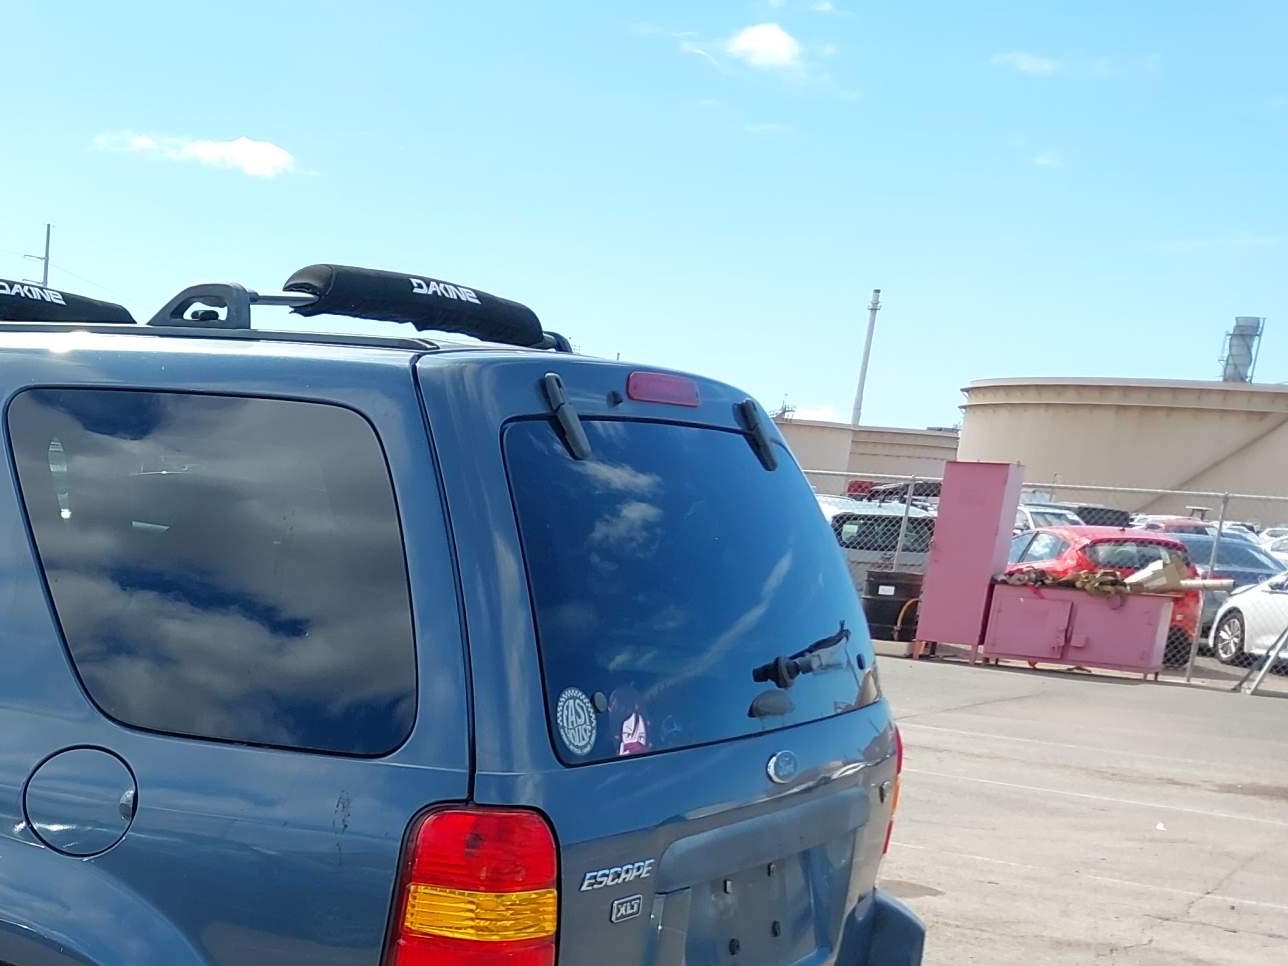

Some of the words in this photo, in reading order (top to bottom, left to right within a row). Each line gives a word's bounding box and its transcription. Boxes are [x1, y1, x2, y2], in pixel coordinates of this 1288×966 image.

[408, 277, 481, 304] DAKINE
[563, 699, 590, 728] FAST
[580, 859, 655, 891] ESCAPE
[616, 900, 640, 917] XLT
